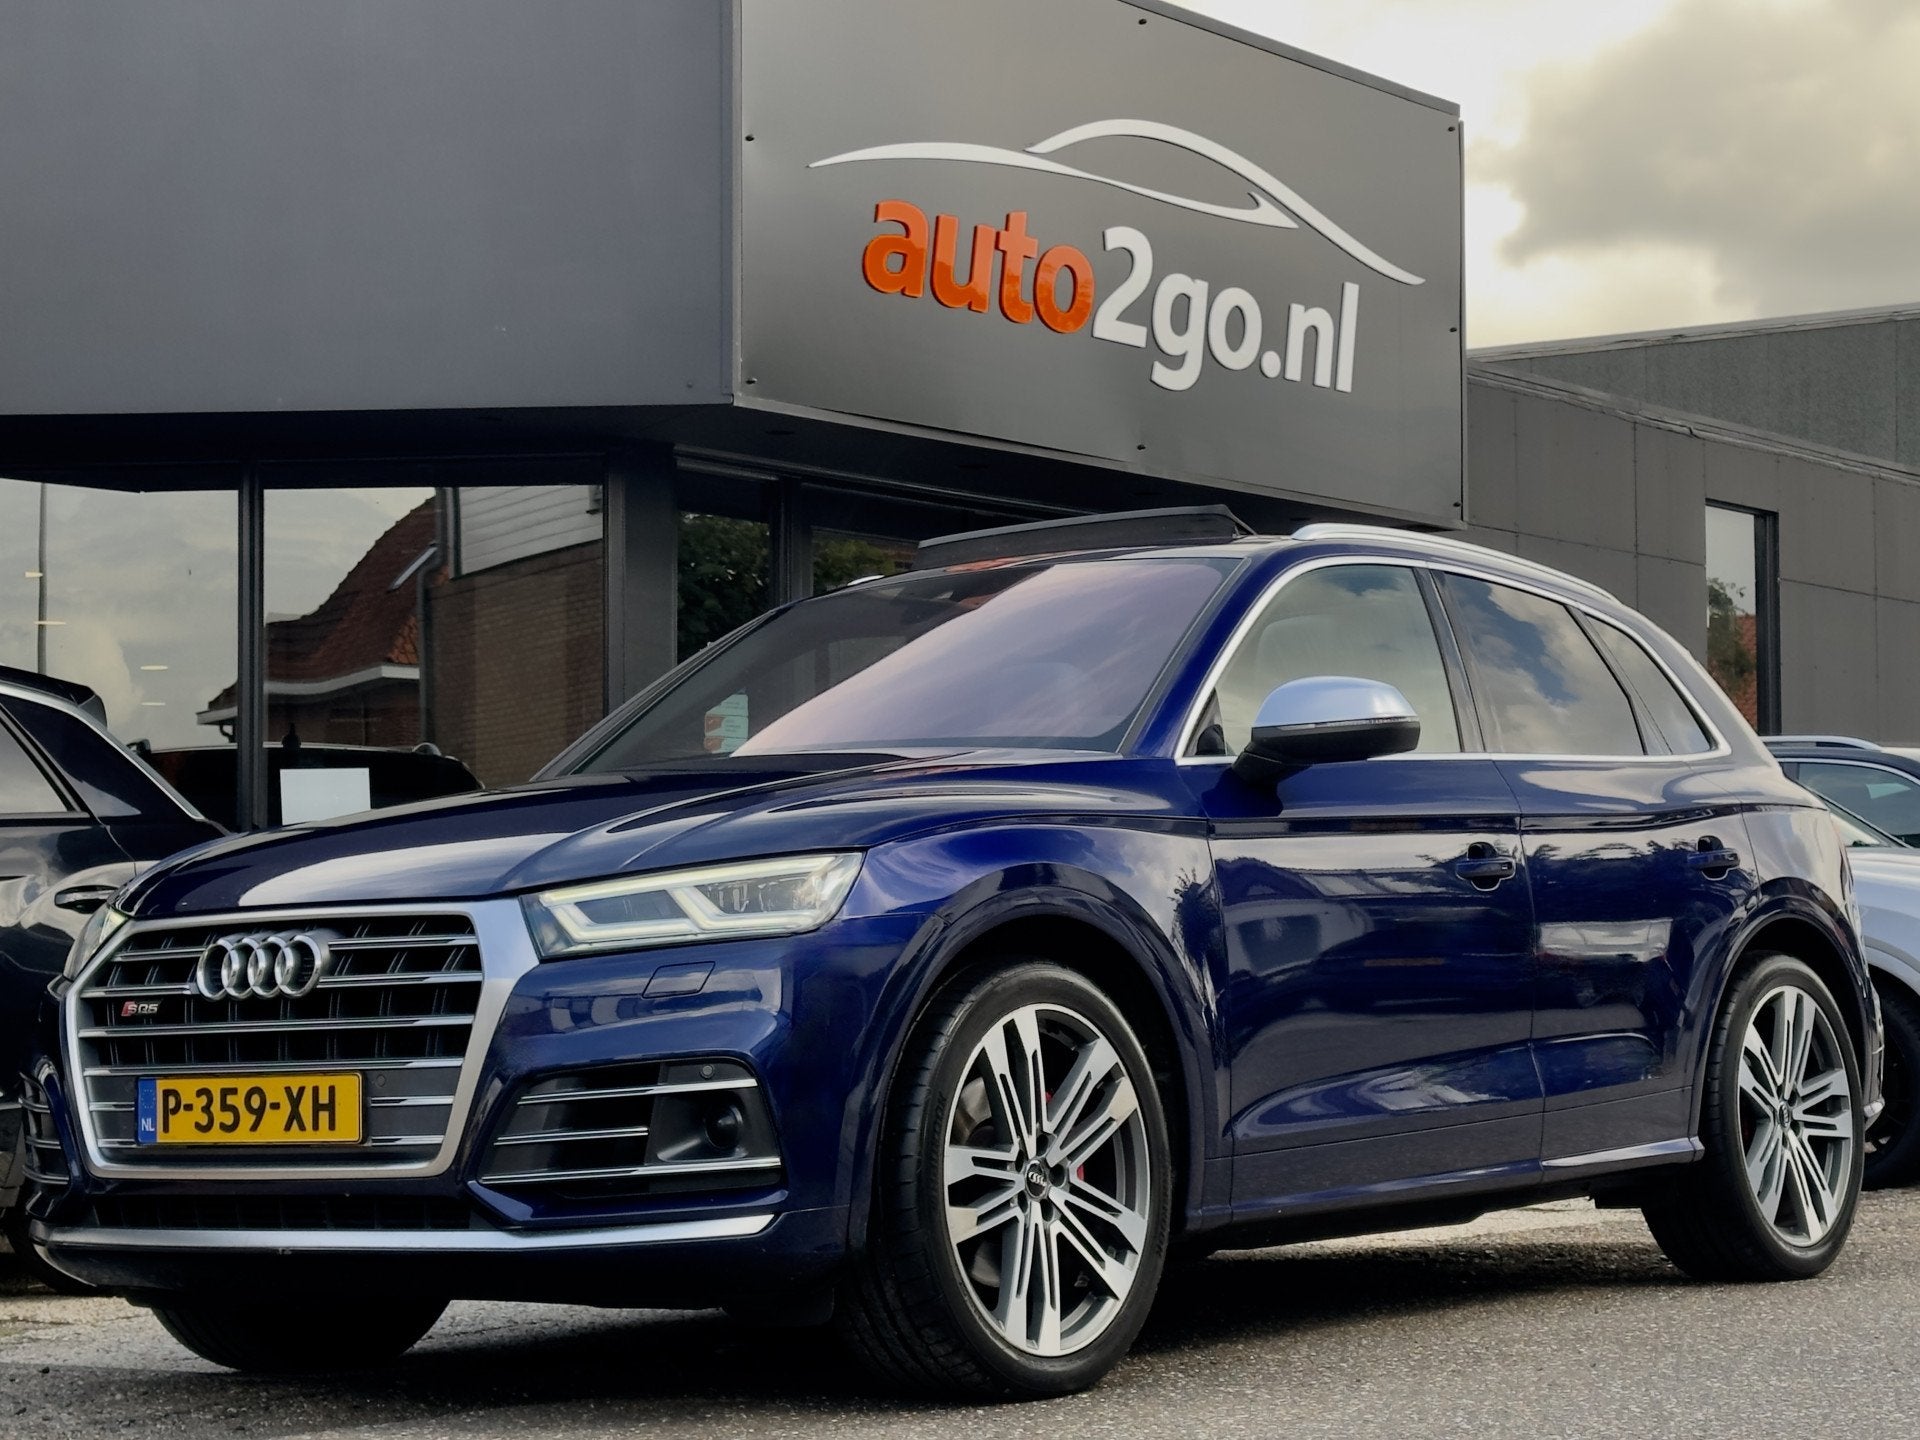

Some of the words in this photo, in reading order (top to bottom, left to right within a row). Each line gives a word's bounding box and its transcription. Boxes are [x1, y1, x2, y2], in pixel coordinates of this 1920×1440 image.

[862, 199, 1360, 393] auto2go.nl
[121, 1001, 159, 1017] SQ5
[141, 1117, 155, 1132] NL
[162, 1085, 336, 1134] P-359-XH
